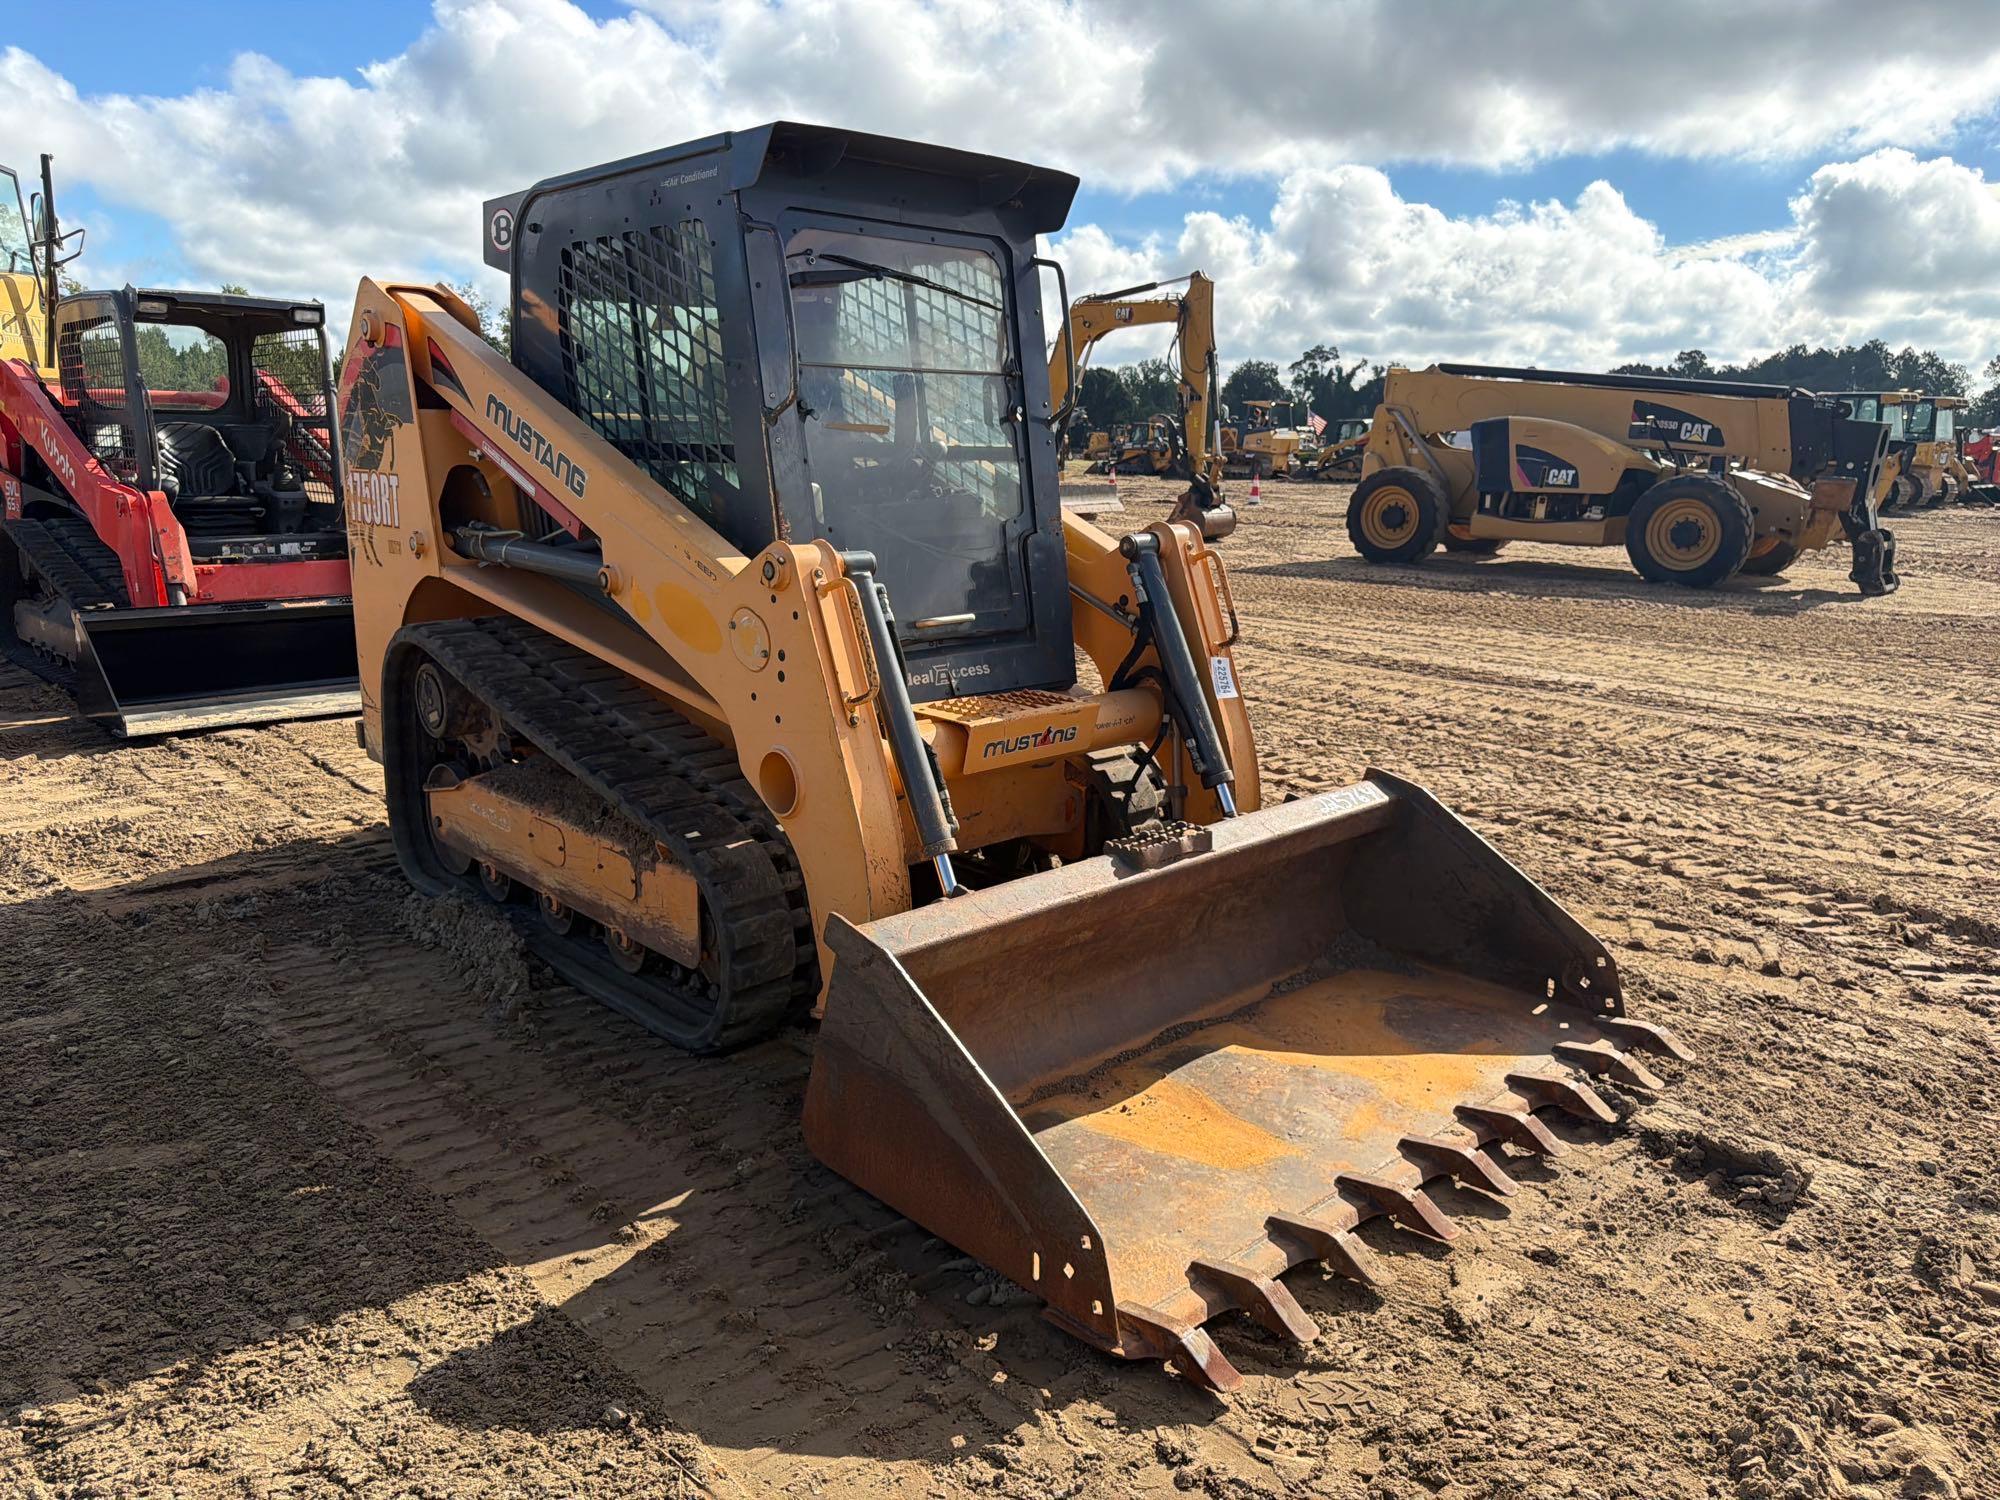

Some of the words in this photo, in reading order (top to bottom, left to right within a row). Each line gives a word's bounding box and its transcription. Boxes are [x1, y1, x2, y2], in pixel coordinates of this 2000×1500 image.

[1115, 307, 1131, 320] CAT
[1680, 422, 1712, 442] CAT
[40, 420, 76, 488] Kubota
[486, 393, 586, 498] MUSTANG
[1548, 468, 1576, 485] CAT
[907, 669, 934, 686] deal
[1217, 666, 1231, 694] 225764
